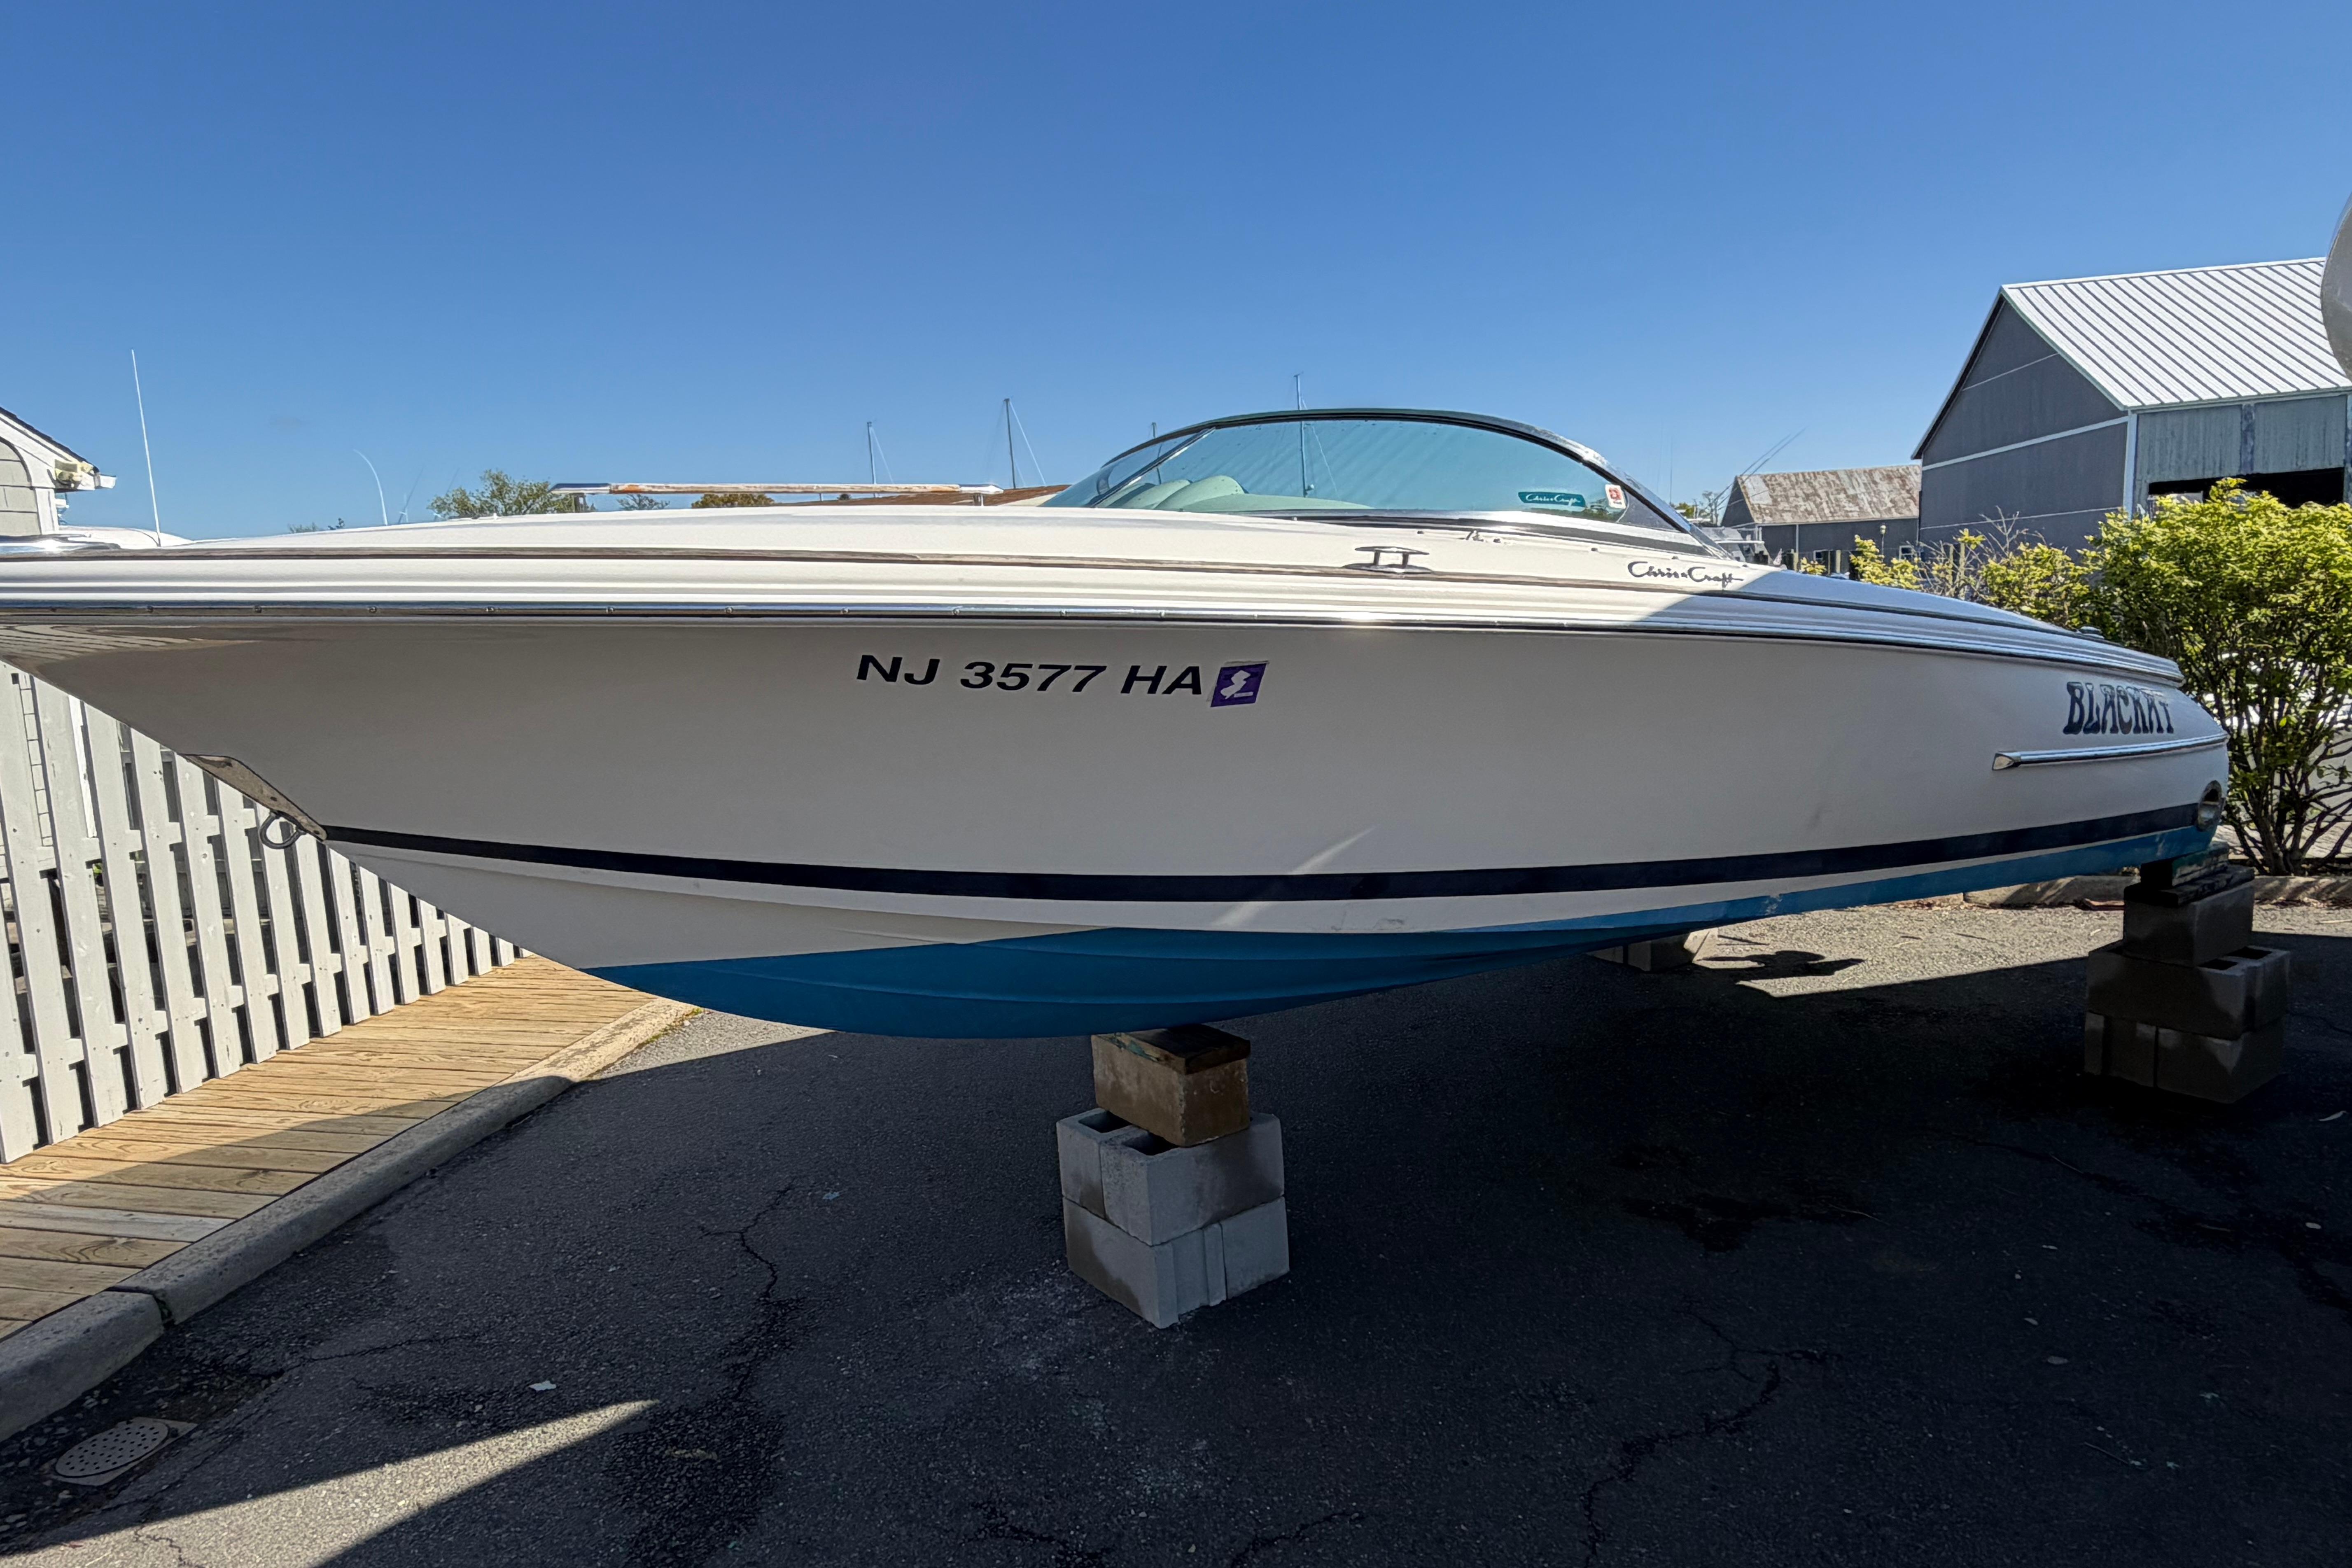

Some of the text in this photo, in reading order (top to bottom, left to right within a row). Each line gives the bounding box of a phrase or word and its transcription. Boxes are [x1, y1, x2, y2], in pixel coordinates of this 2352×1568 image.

[856, 655, 1202, 695] NJ 3577 HA
